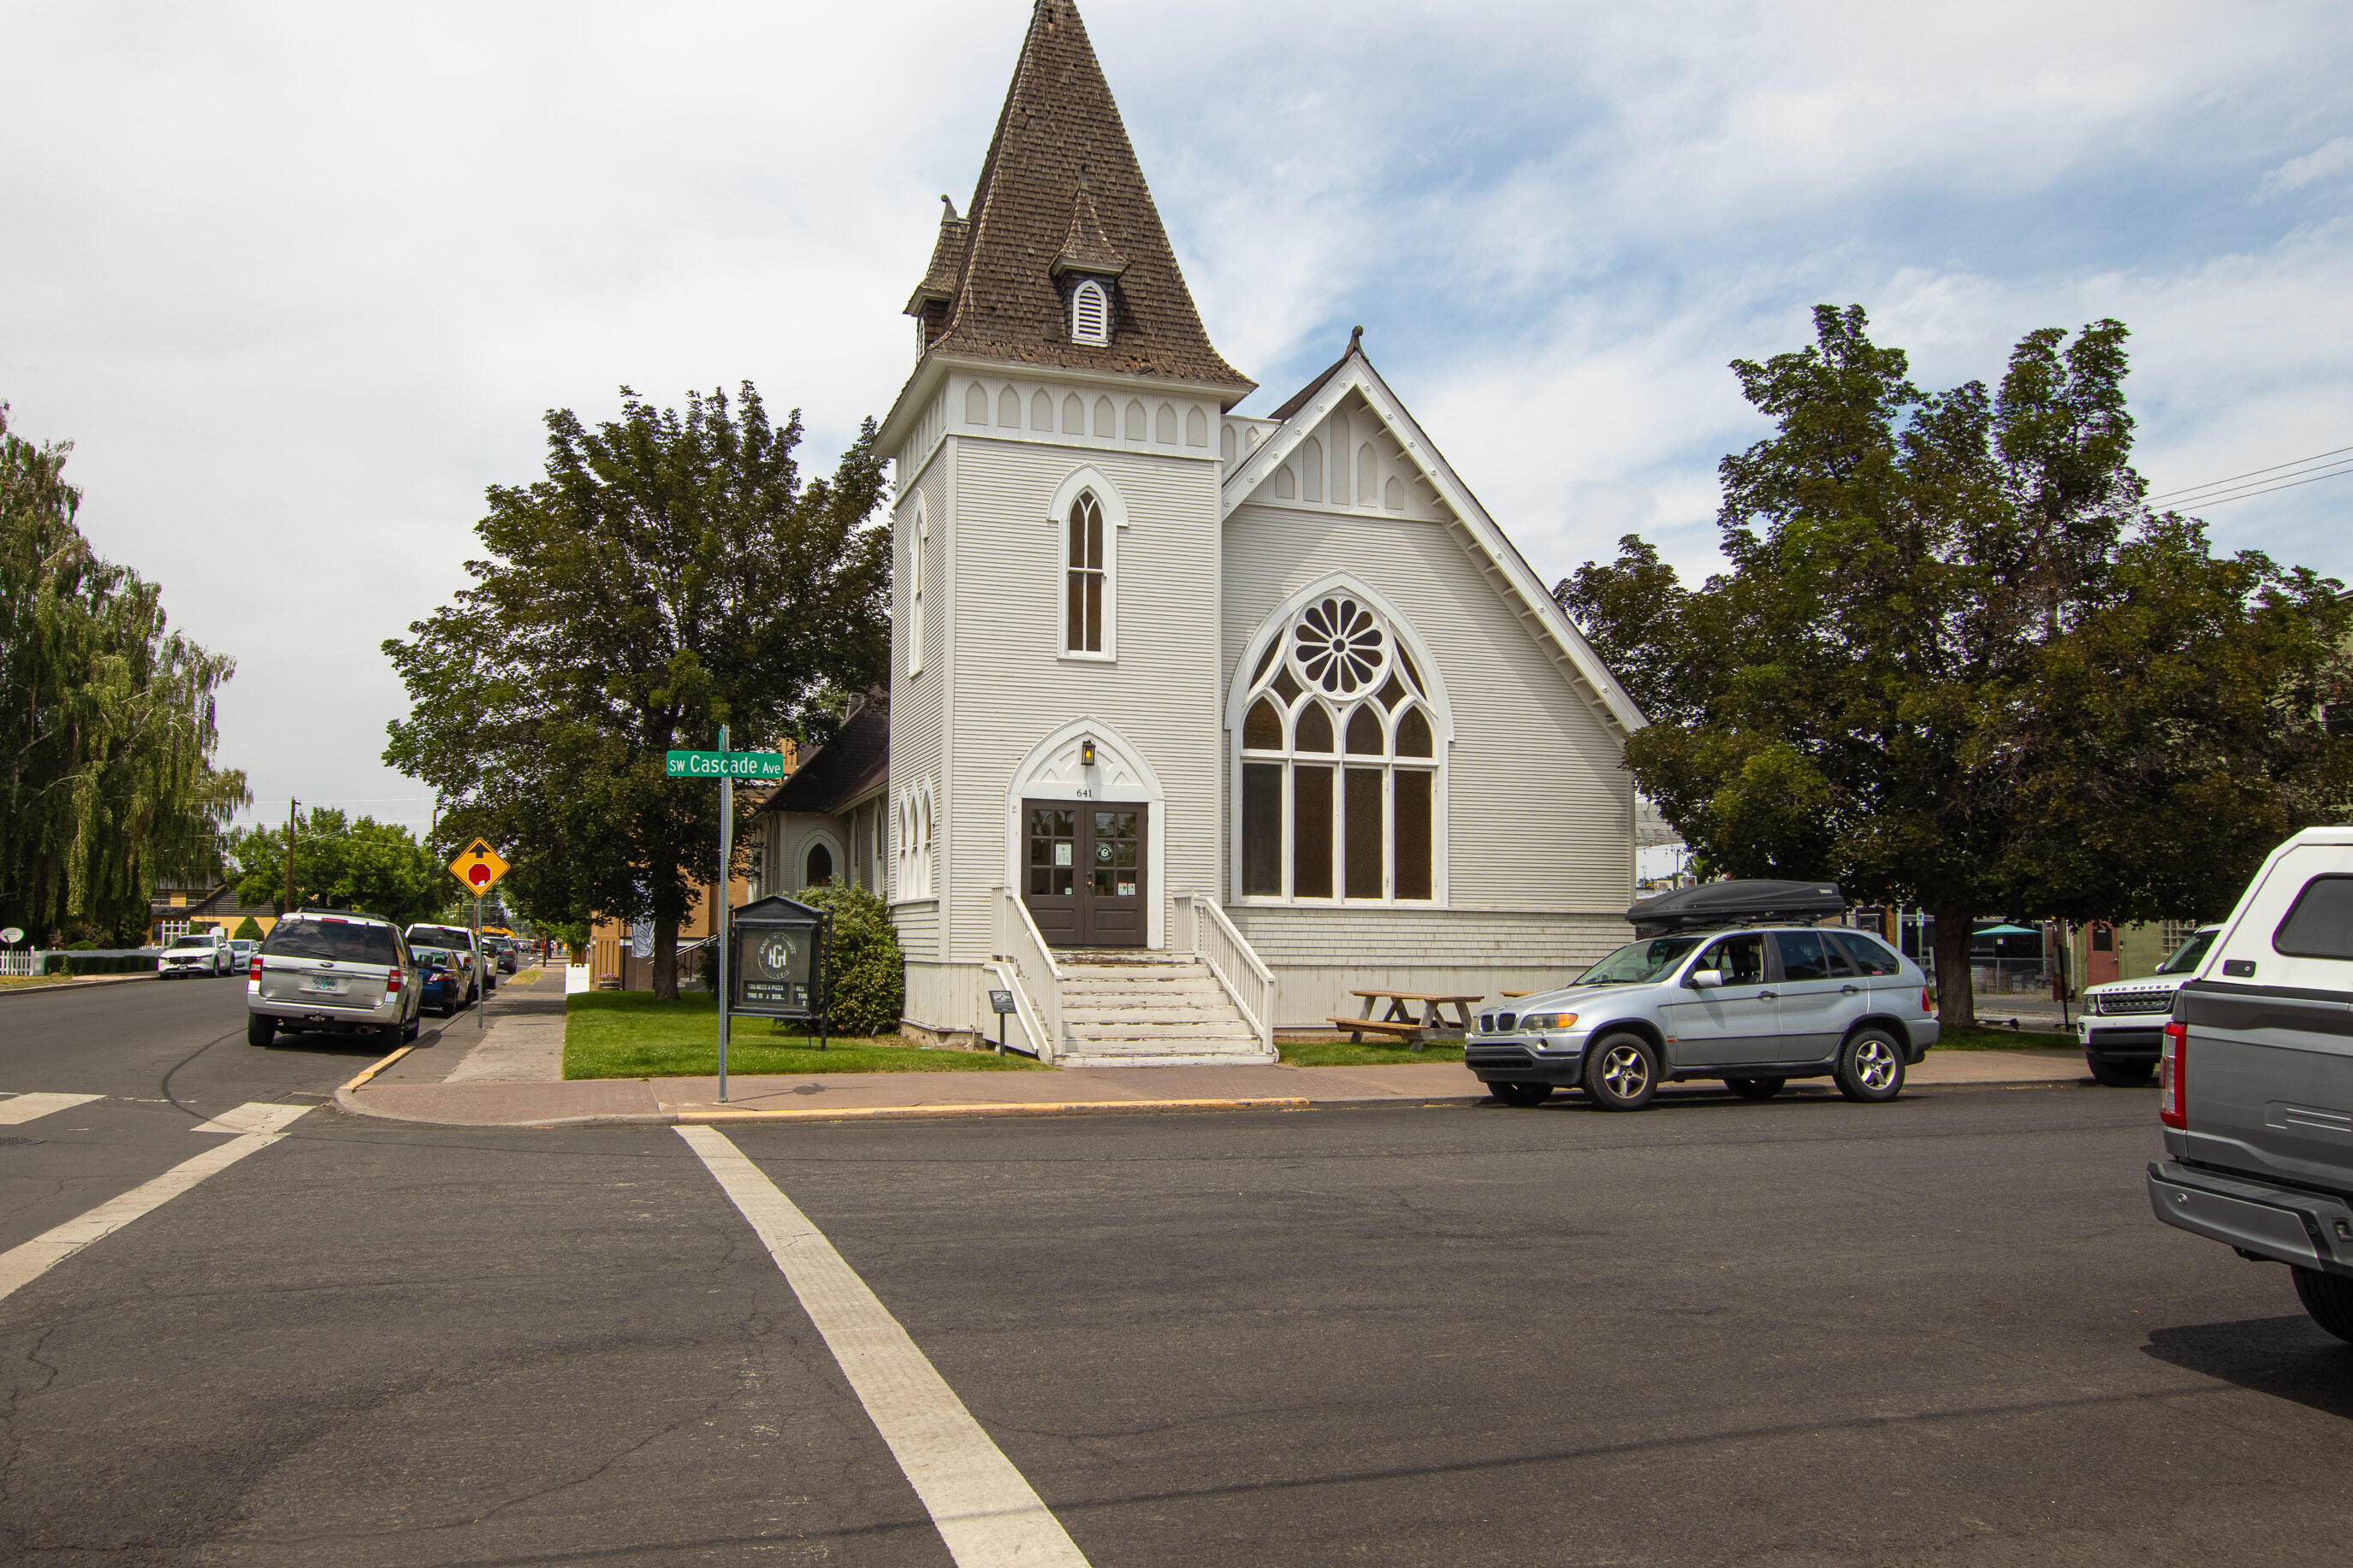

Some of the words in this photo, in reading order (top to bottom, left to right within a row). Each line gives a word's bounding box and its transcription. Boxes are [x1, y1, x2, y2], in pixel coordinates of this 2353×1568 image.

[669, 759, 685, 772] SW
[690, 754, 758, 774] Cascade
[762, 762, 781, 774] Ave
[1076, 789, 1092, 798] 641
